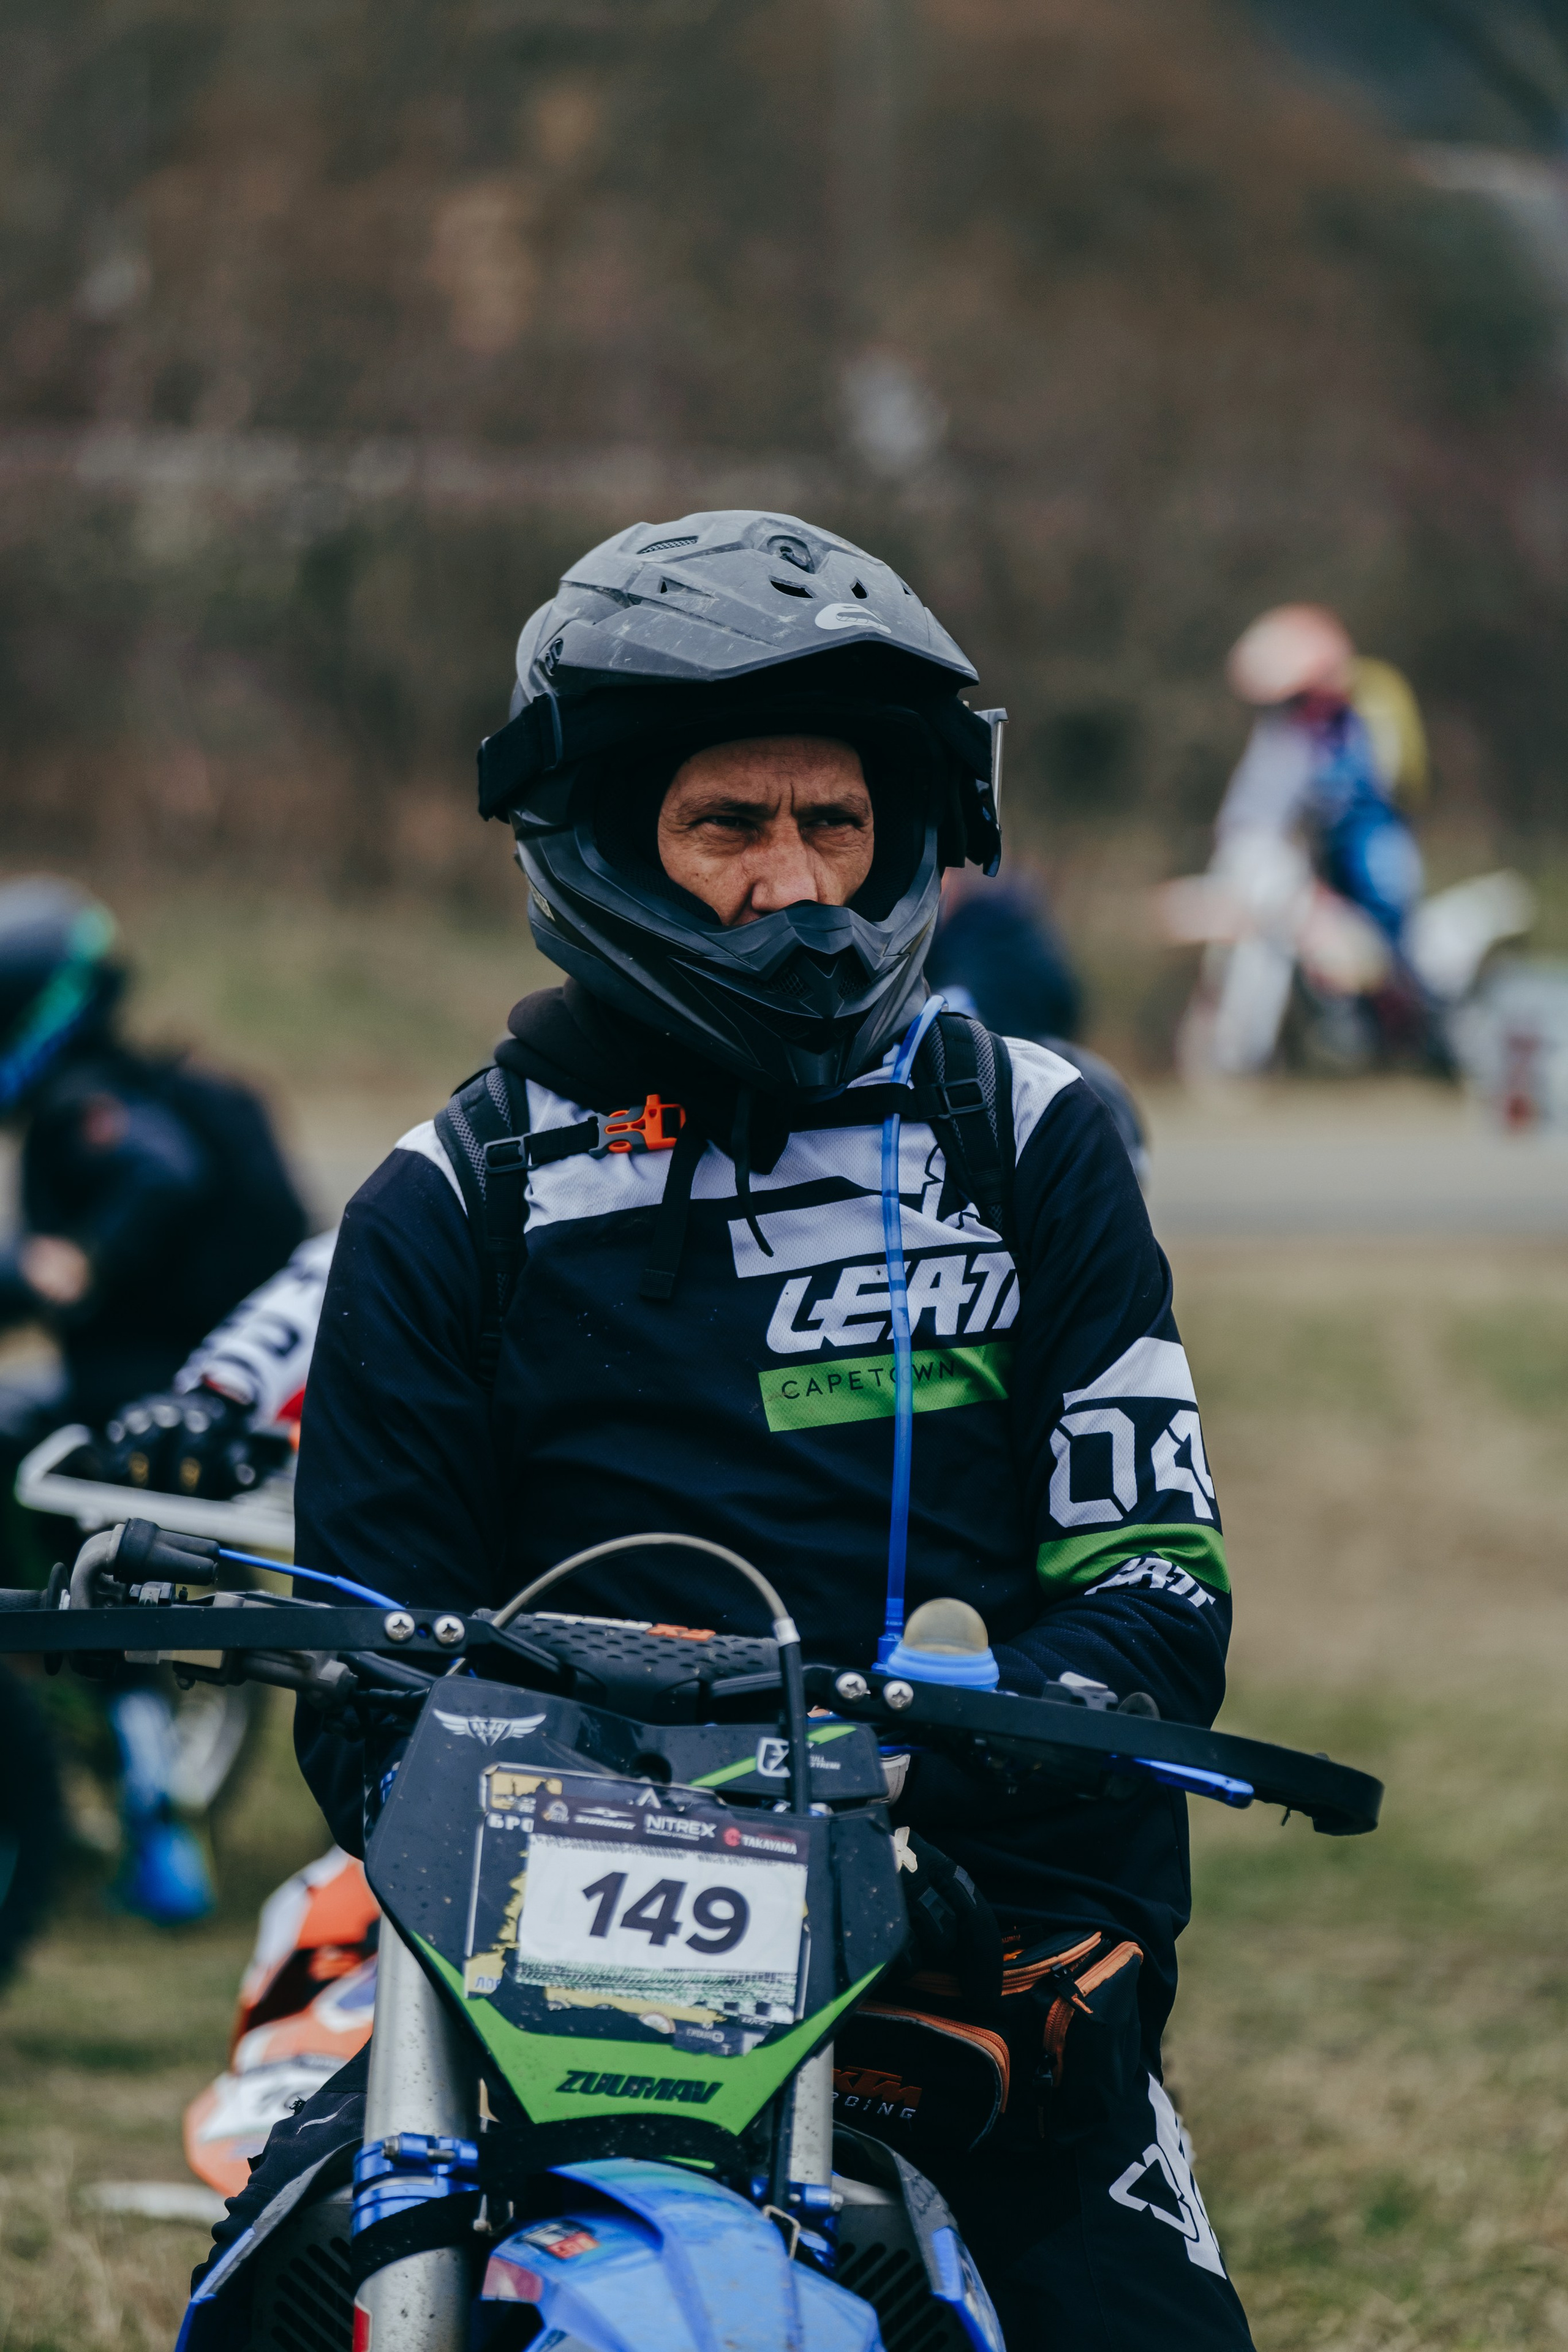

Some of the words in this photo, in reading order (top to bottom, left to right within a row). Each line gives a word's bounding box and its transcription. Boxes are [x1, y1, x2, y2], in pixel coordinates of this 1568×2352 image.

[644, 1814, 717, 1838] NITREX
[742, 1834, 797, 1855] TAKAYAMA
[582, 1871, 750, 1955] 149
[556, 2070, 724, 2105] ZUUMAV
